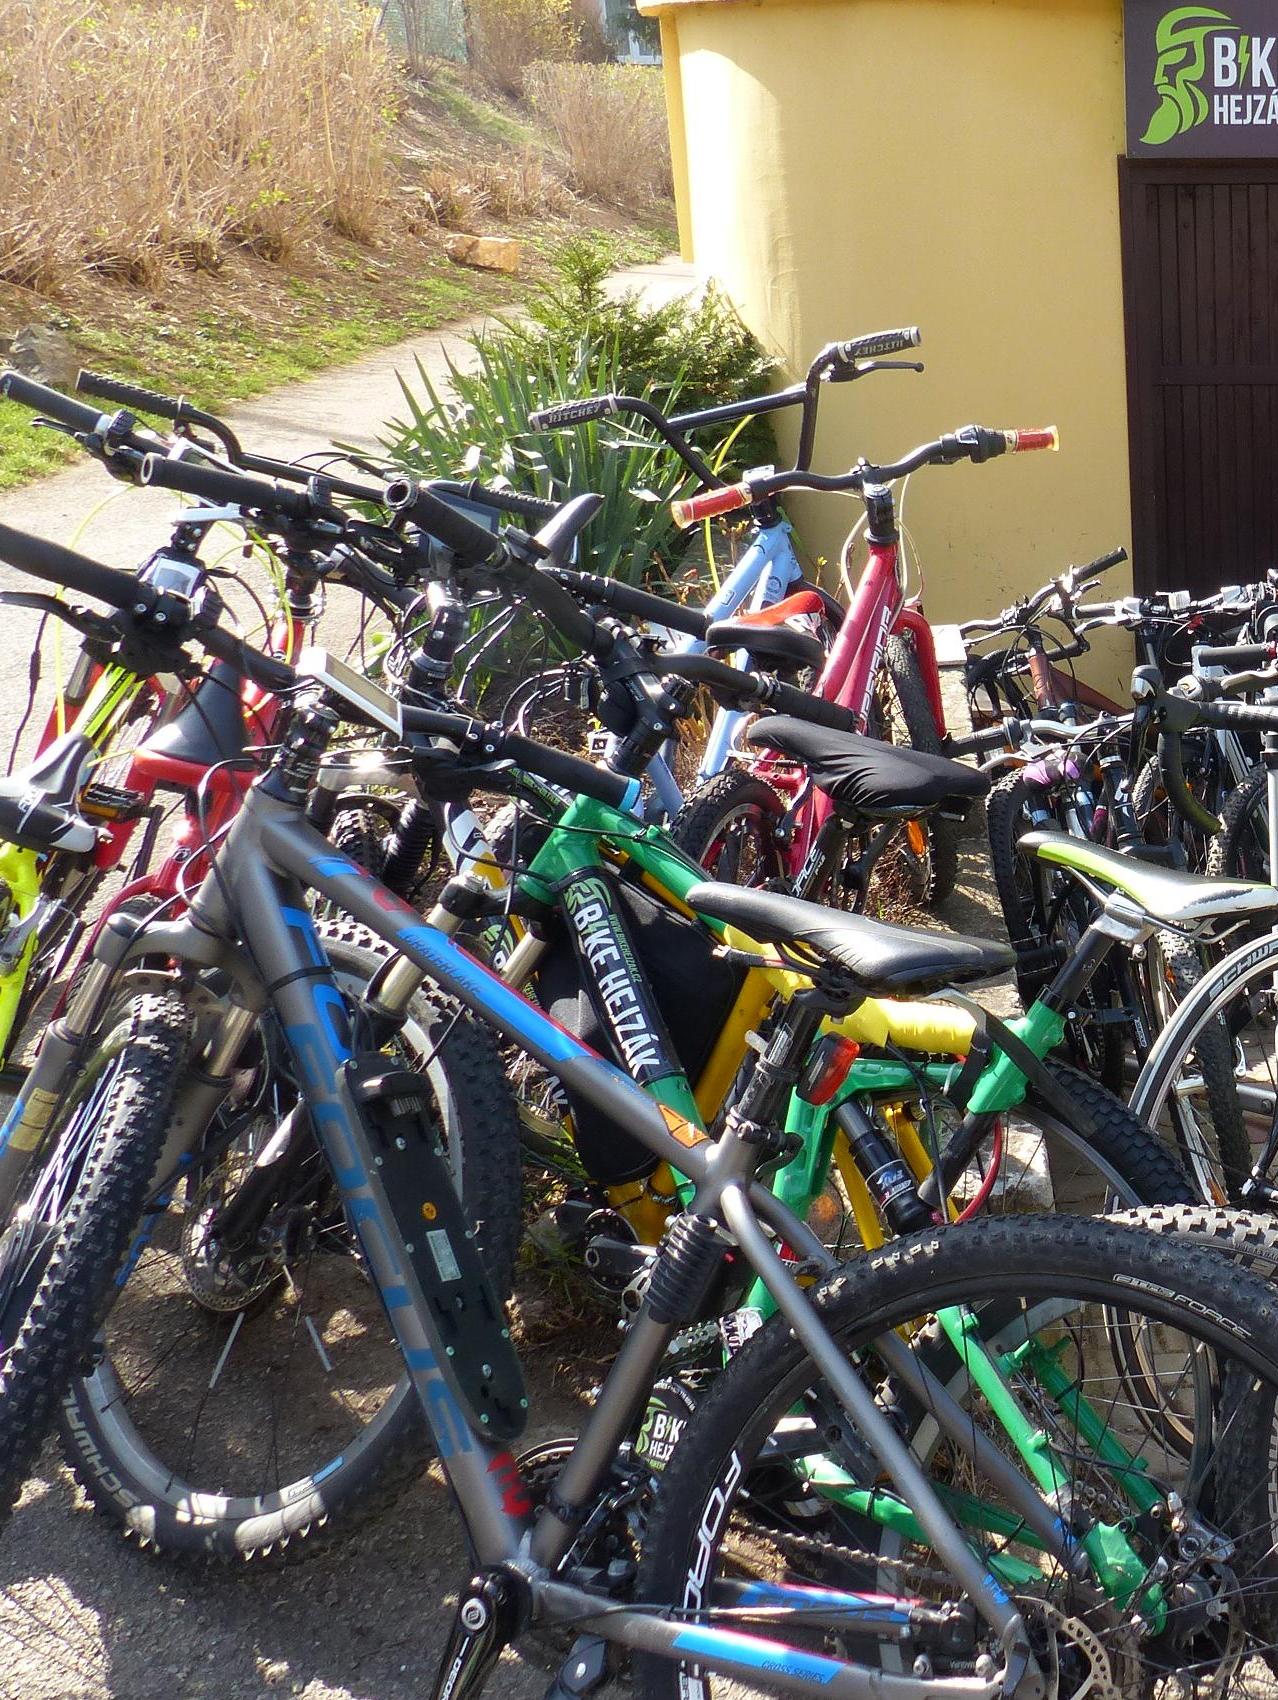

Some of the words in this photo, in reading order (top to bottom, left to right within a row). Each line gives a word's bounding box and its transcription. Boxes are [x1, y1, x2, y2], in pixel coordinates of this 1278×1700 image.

[856, 605, 891, 734] UPERIOR
[574, 902, 622, 974] BIKE
[598, 968, 661, 1080] HEJZÁK
[287, 1023, 475, 1459] FOCUS
[62, 1384, 142, 1508] SCHWAL
[649, 1441, 675, 1461] HEJZ
[653, 1413, 687, 1444] BIK
[683, 1449, 742, 1624] FORC
